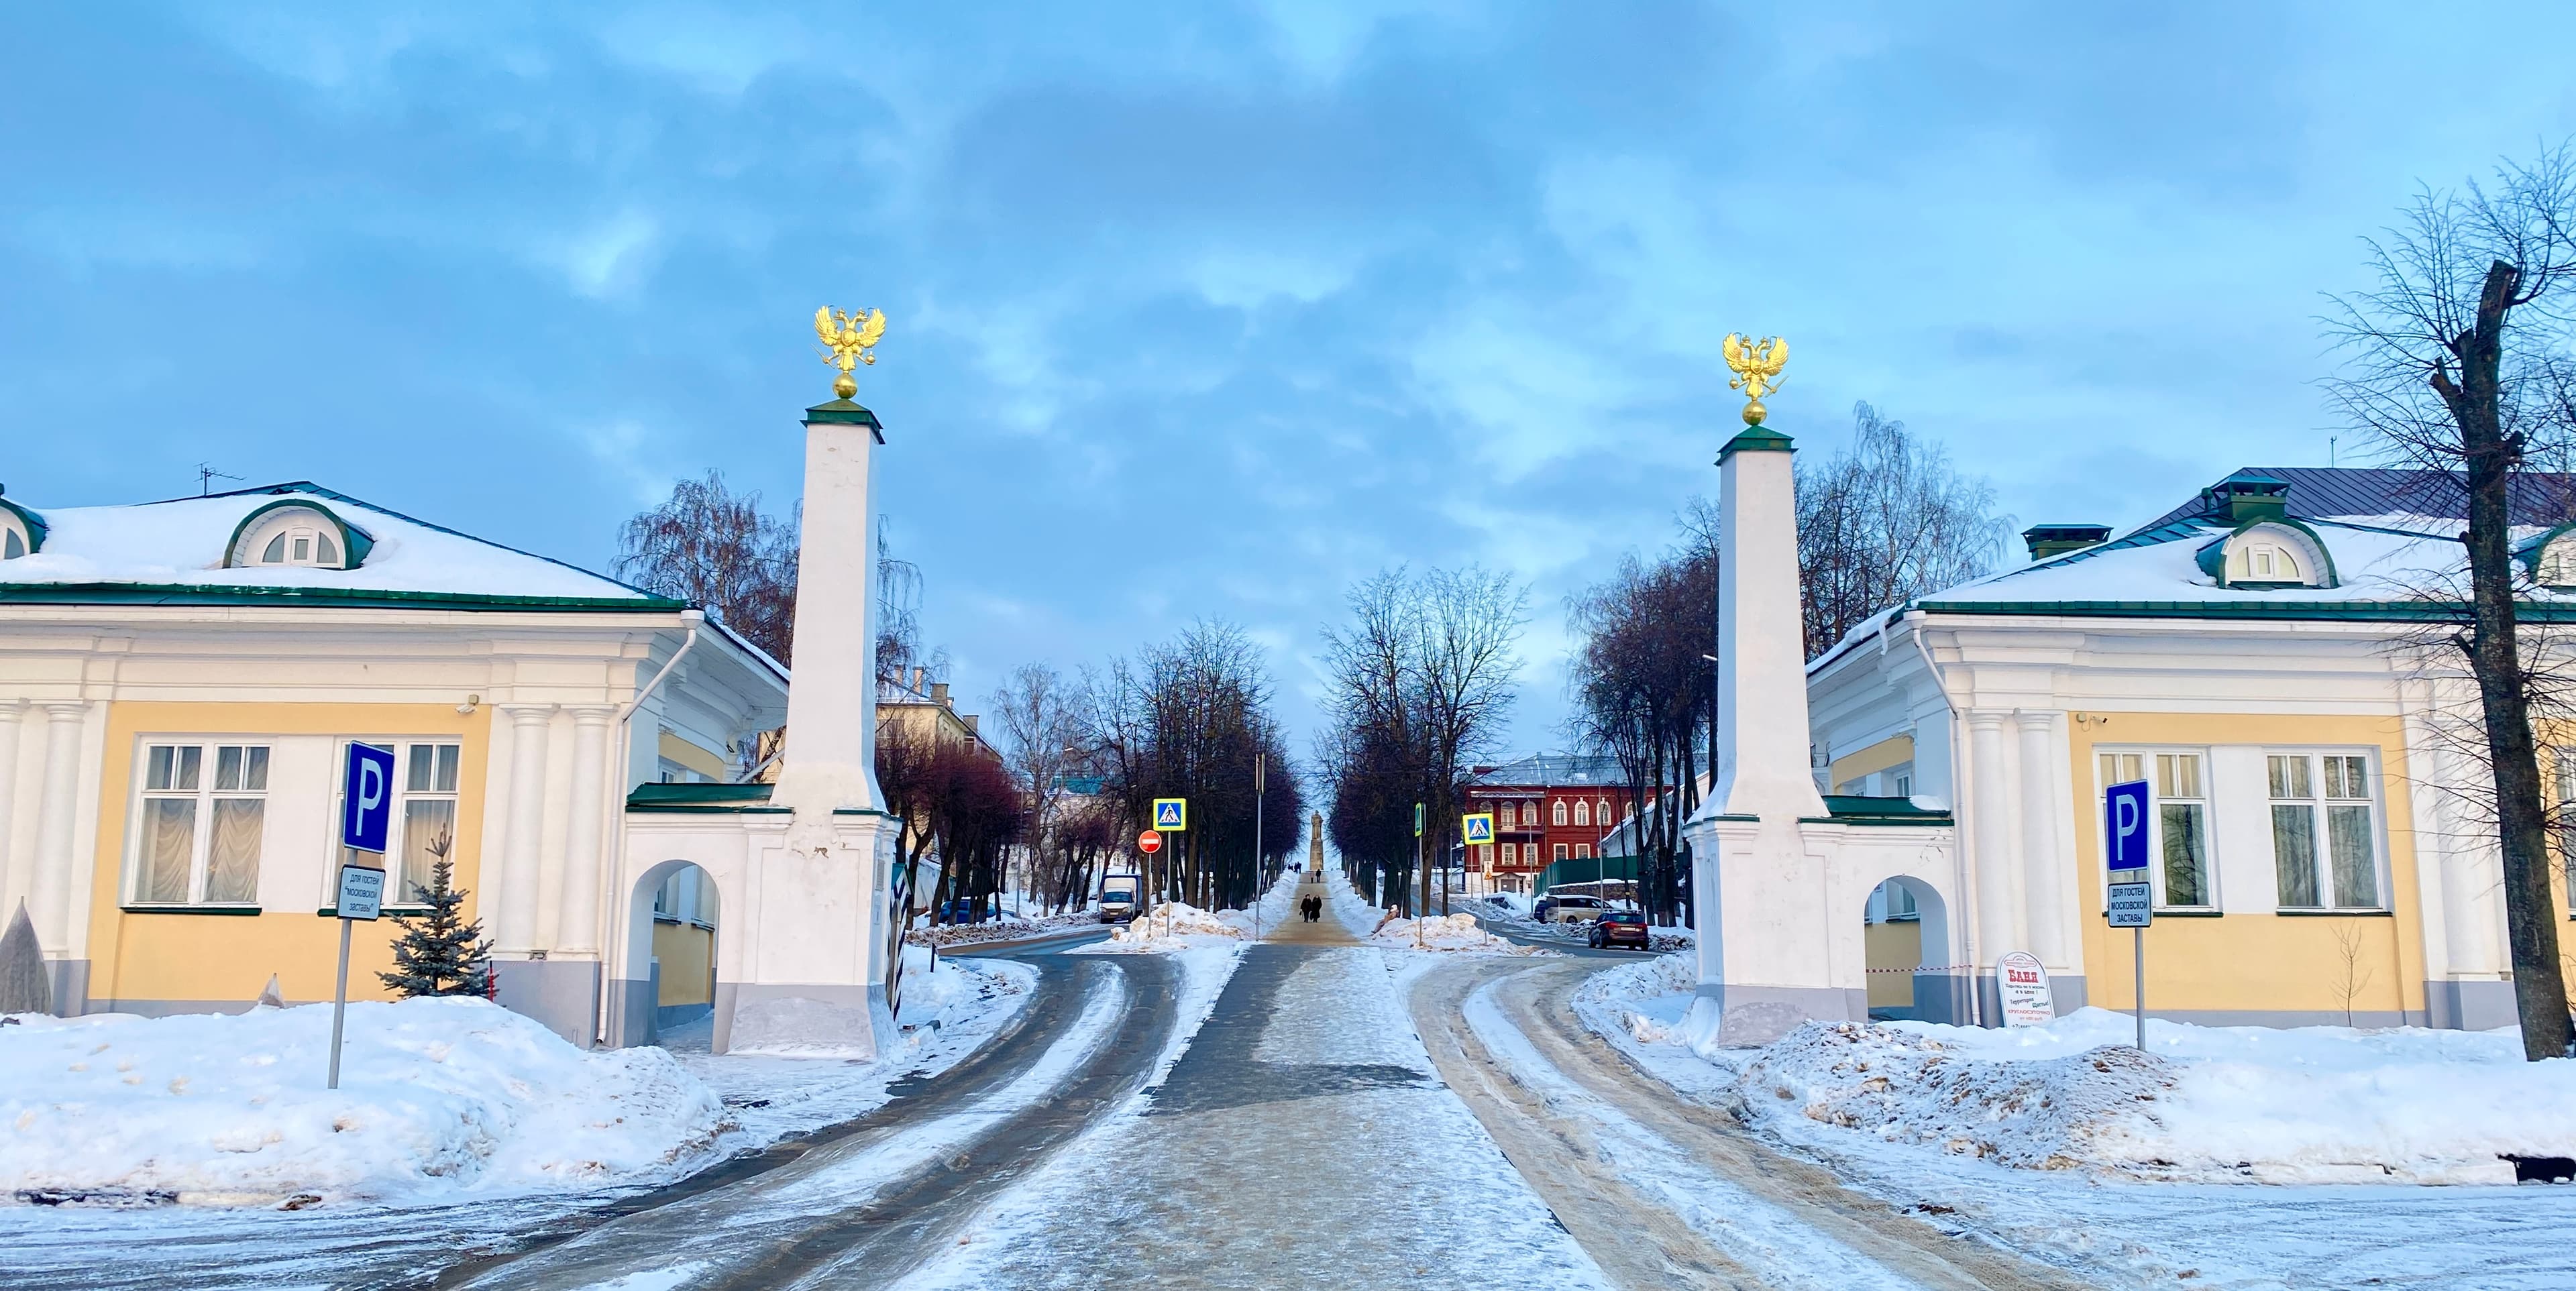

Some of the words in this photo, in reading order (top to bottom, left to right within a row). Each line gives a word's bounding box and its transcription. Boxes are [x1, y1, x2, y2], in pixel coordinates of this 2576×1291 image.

[356, 757, 383, 836] P
[2116, 794, 2139, 861] P
[2112, 889, 2123, 898] ДЛЯ
[2124, 886, 2145, 897] ГОСТЕЙ
[2111, 899, 2148, 910] МОСКОВСКОЙ
[2116, 913, 2143, 923] ЗАСТАВЫ
